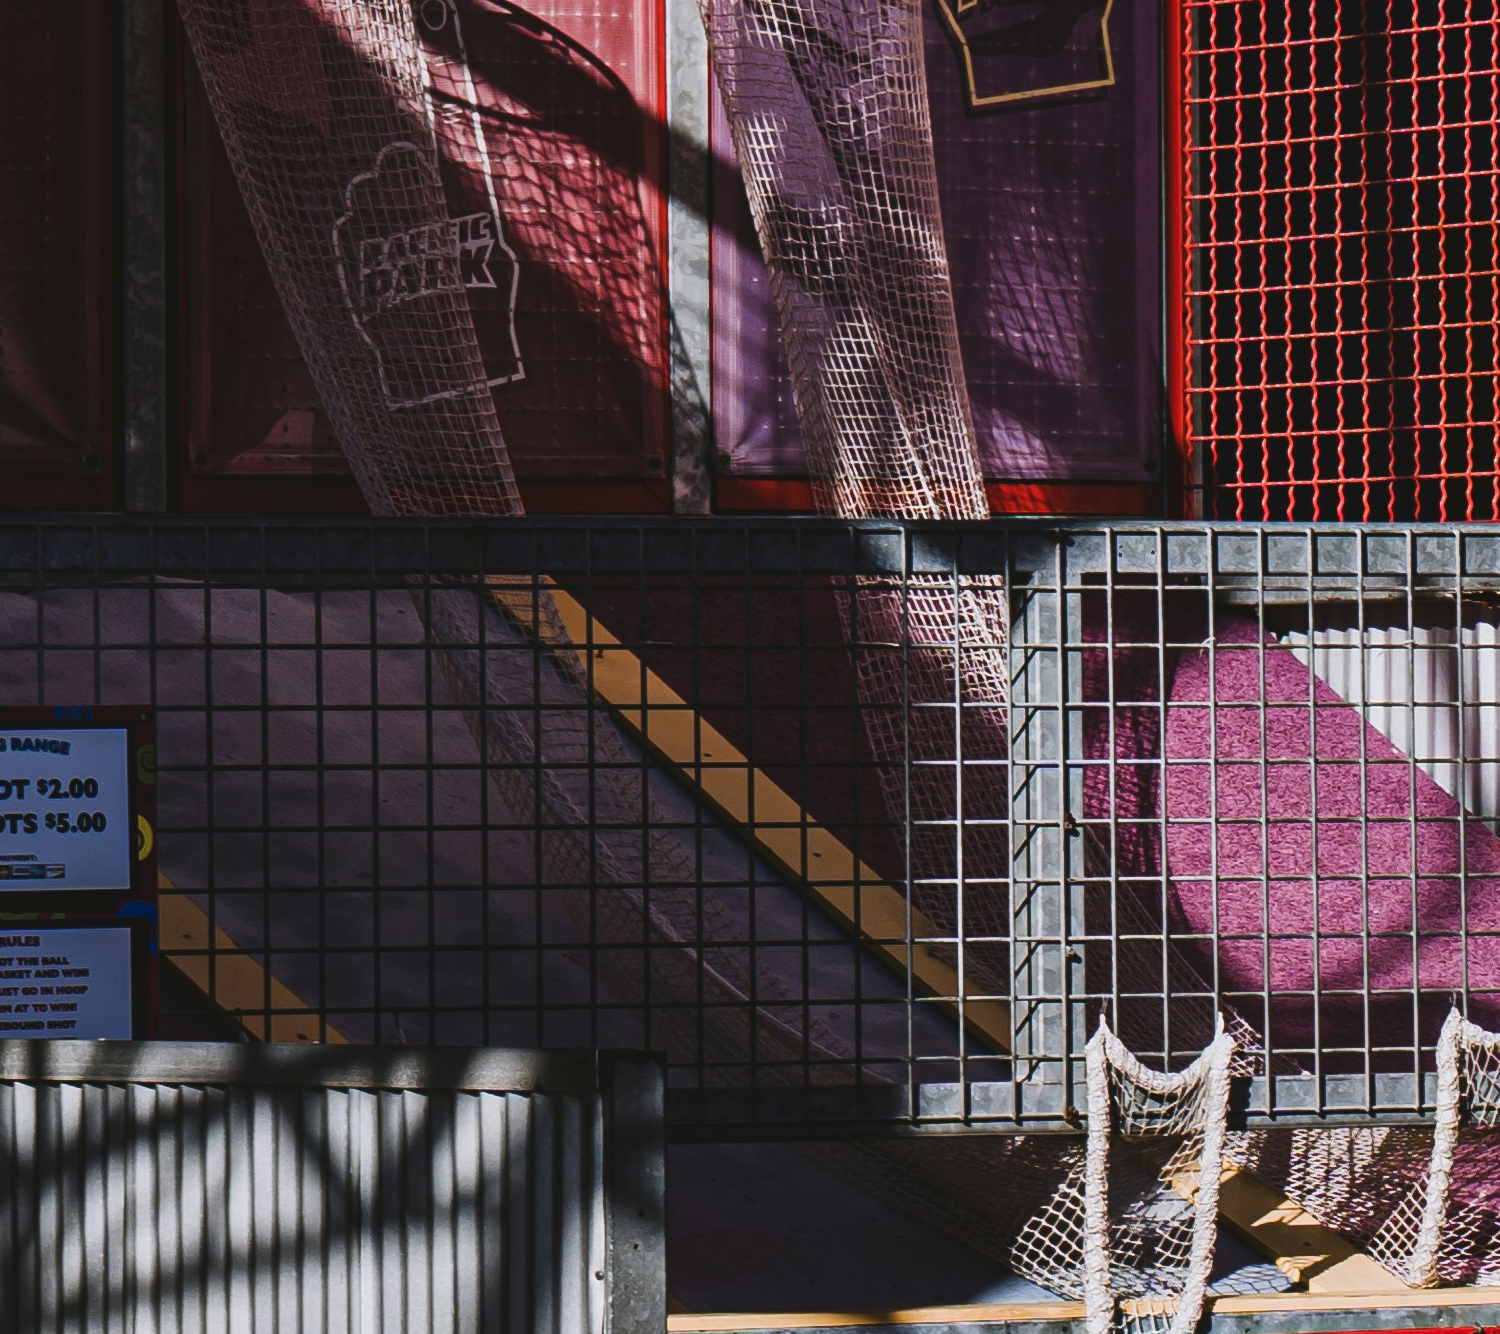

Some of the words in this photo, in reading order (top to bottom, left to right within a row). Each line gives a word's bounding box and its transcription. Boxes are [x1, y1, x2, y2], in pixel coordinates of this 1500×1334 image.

[10, 736, 71, 756] RANGE
[36, 778, 99, 799] $2.00
[44, 811, 107, 833] $5.00
[17, 956, 40, 966] THE
[41, 956, 70, 966] BALL
[34, 969, 60, 979] AND
[21, 986, 39, 996] GO
[40, 986, 54, 995] IN
[55, 985, 89, 995] HOOP
[14, 1004, 30, 1013] AT
[31, 1003, 48, 1013] TO
[46, 1019, 77, 1030] SHOT
